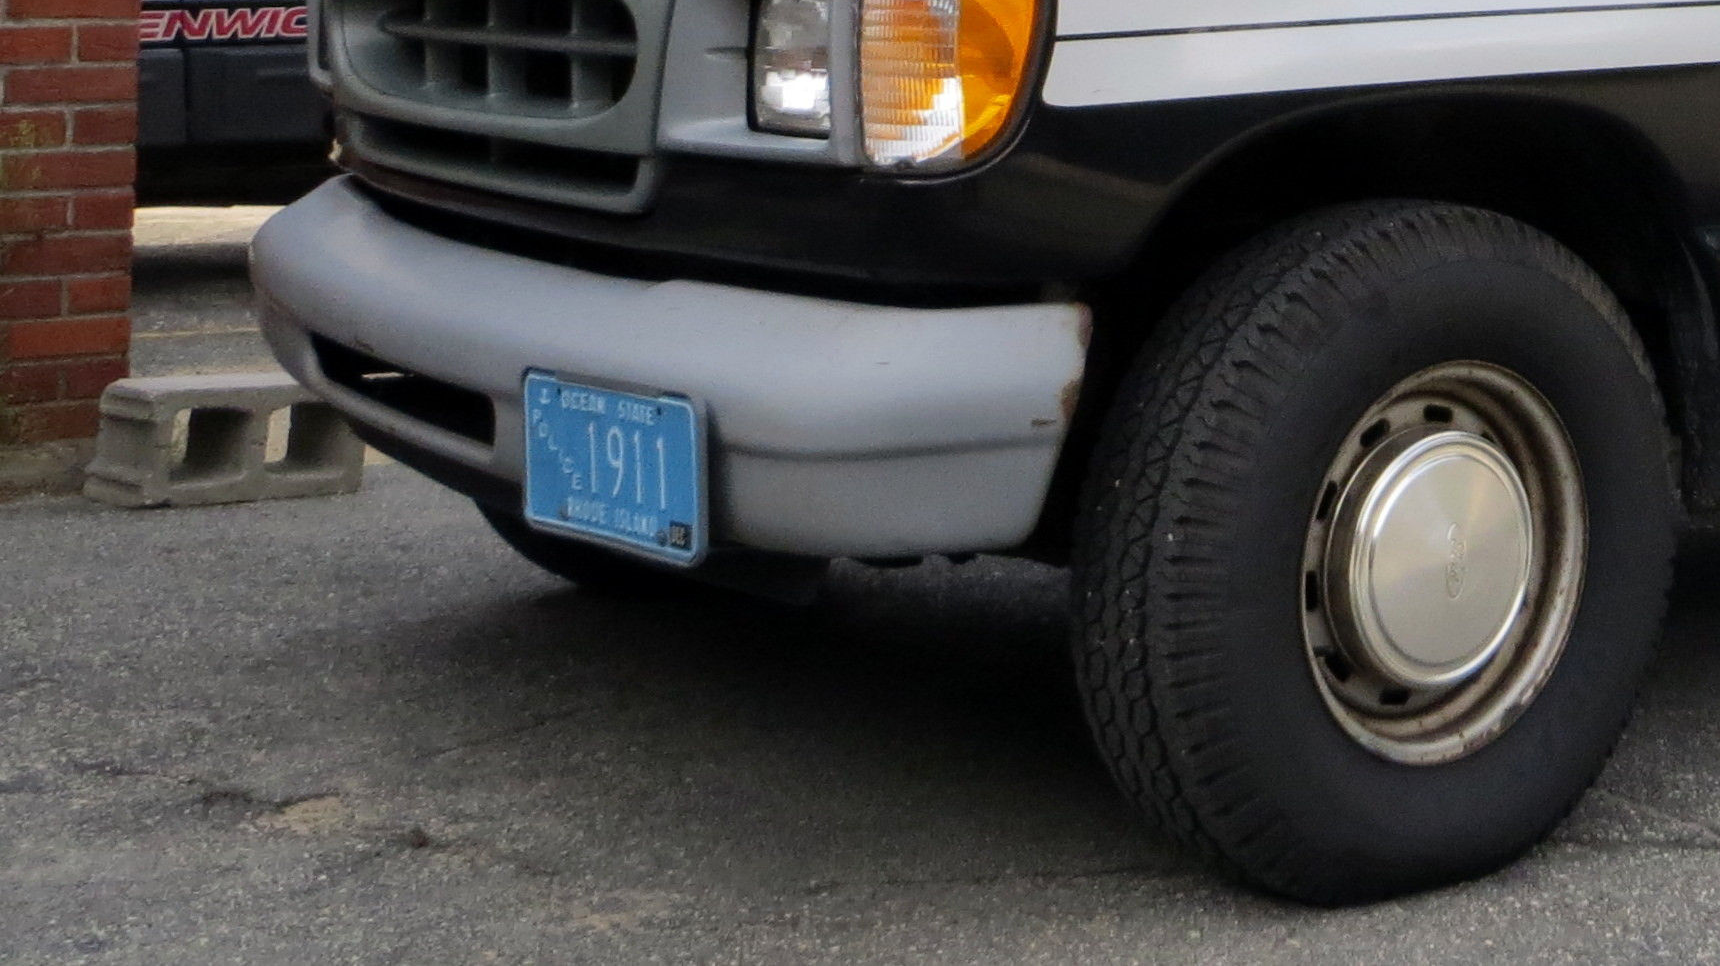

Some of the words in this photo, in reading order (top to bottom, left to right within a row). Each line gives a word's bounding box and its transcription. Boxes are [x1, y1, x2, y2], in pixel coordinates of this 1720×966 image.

[561, 389, 606, 414] OCEAN
[618, 400, 655, 425] STATE
[588, 421, 667, 511] 1911
